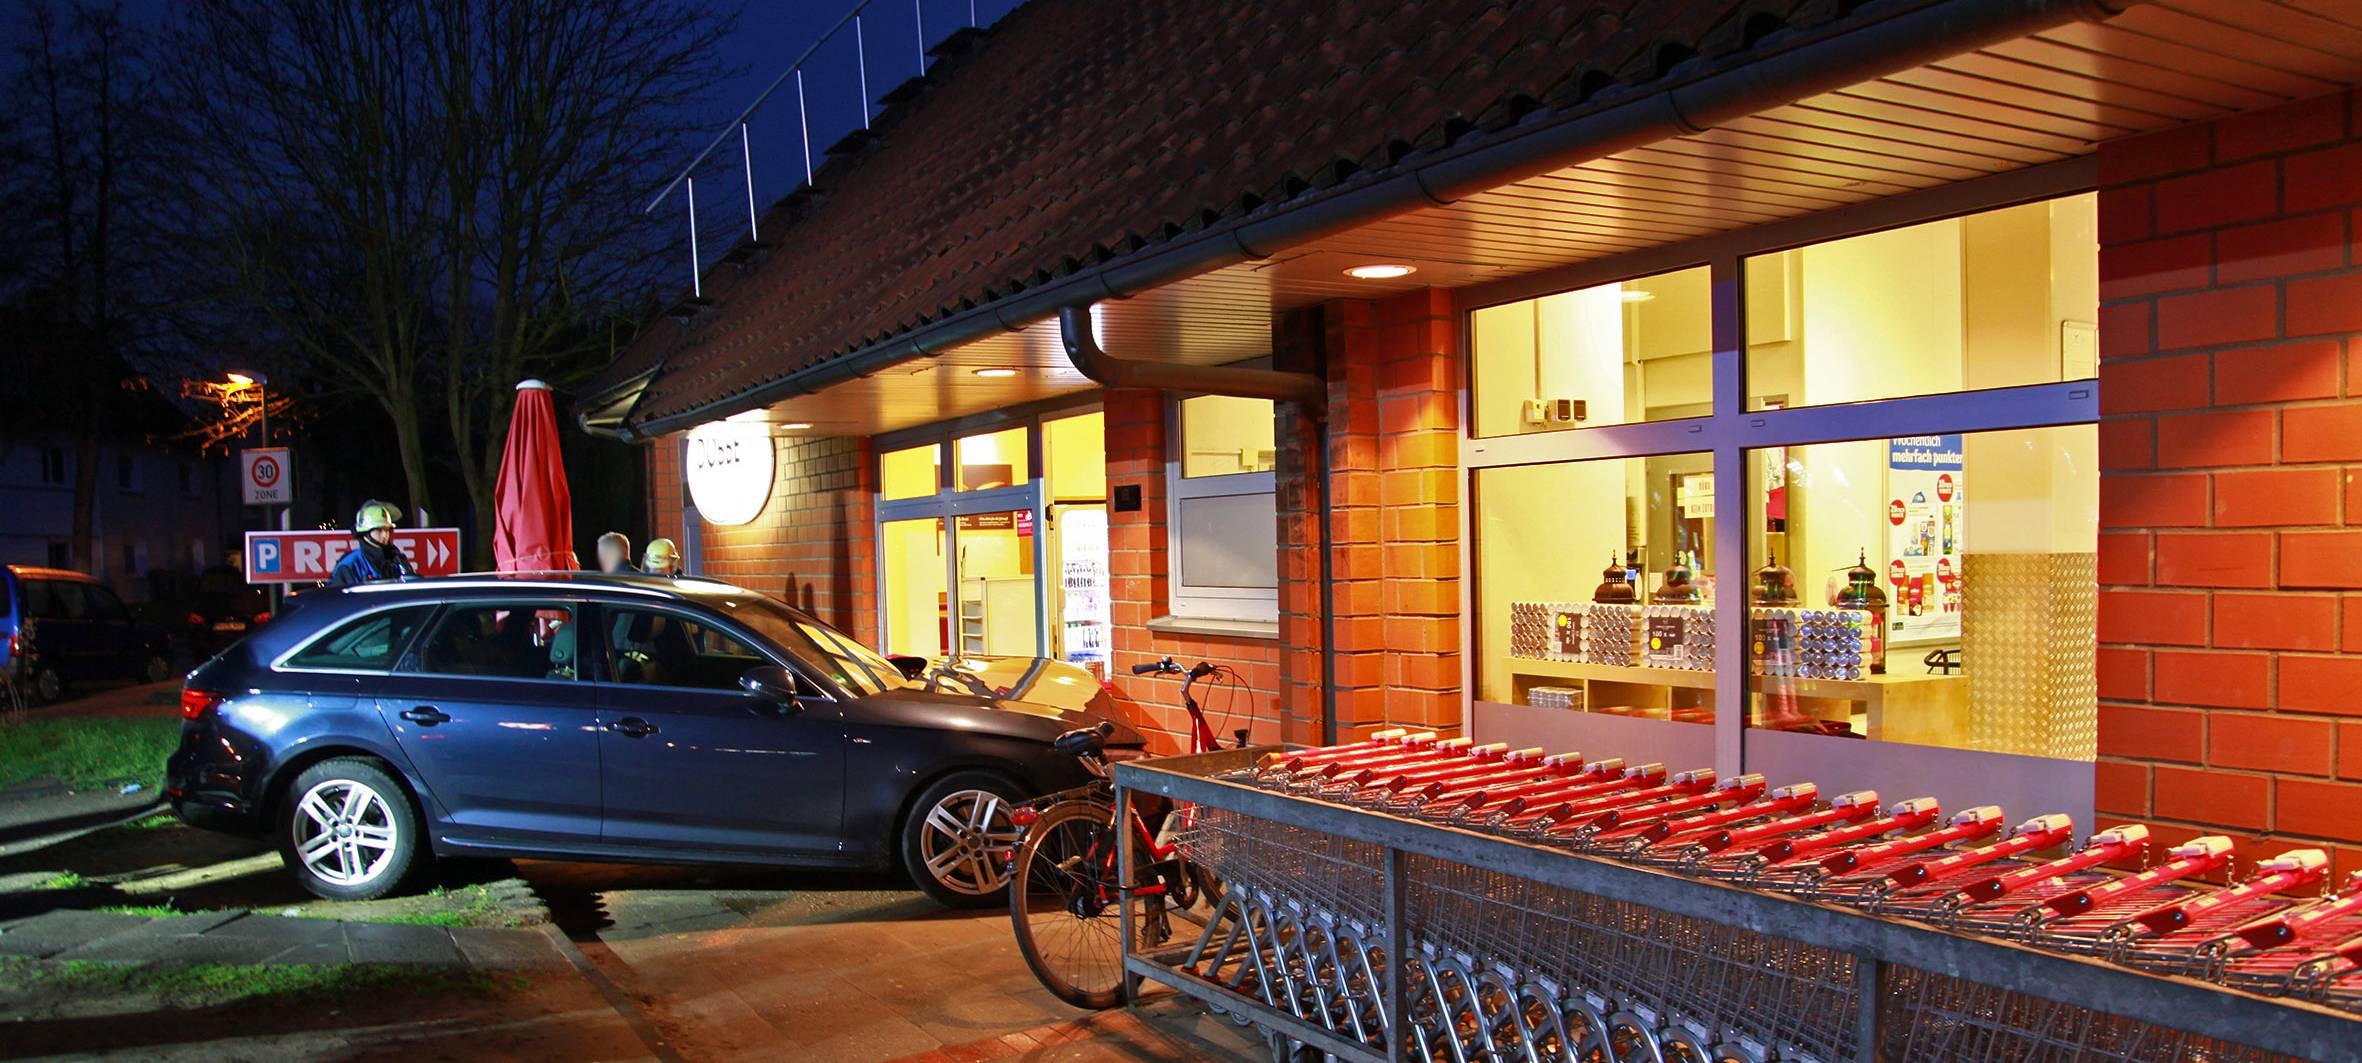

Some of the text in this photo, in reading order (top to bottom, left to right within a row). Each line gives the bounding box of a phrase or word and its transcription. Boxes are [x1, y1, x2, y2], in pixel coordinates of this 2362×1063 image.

[1892, 448, 1933, 463] mehrfach
[257, 464, 274, 480] 30
[255, 489, 279, 499] ZONE
[258, 538, 419, 573] P REE
